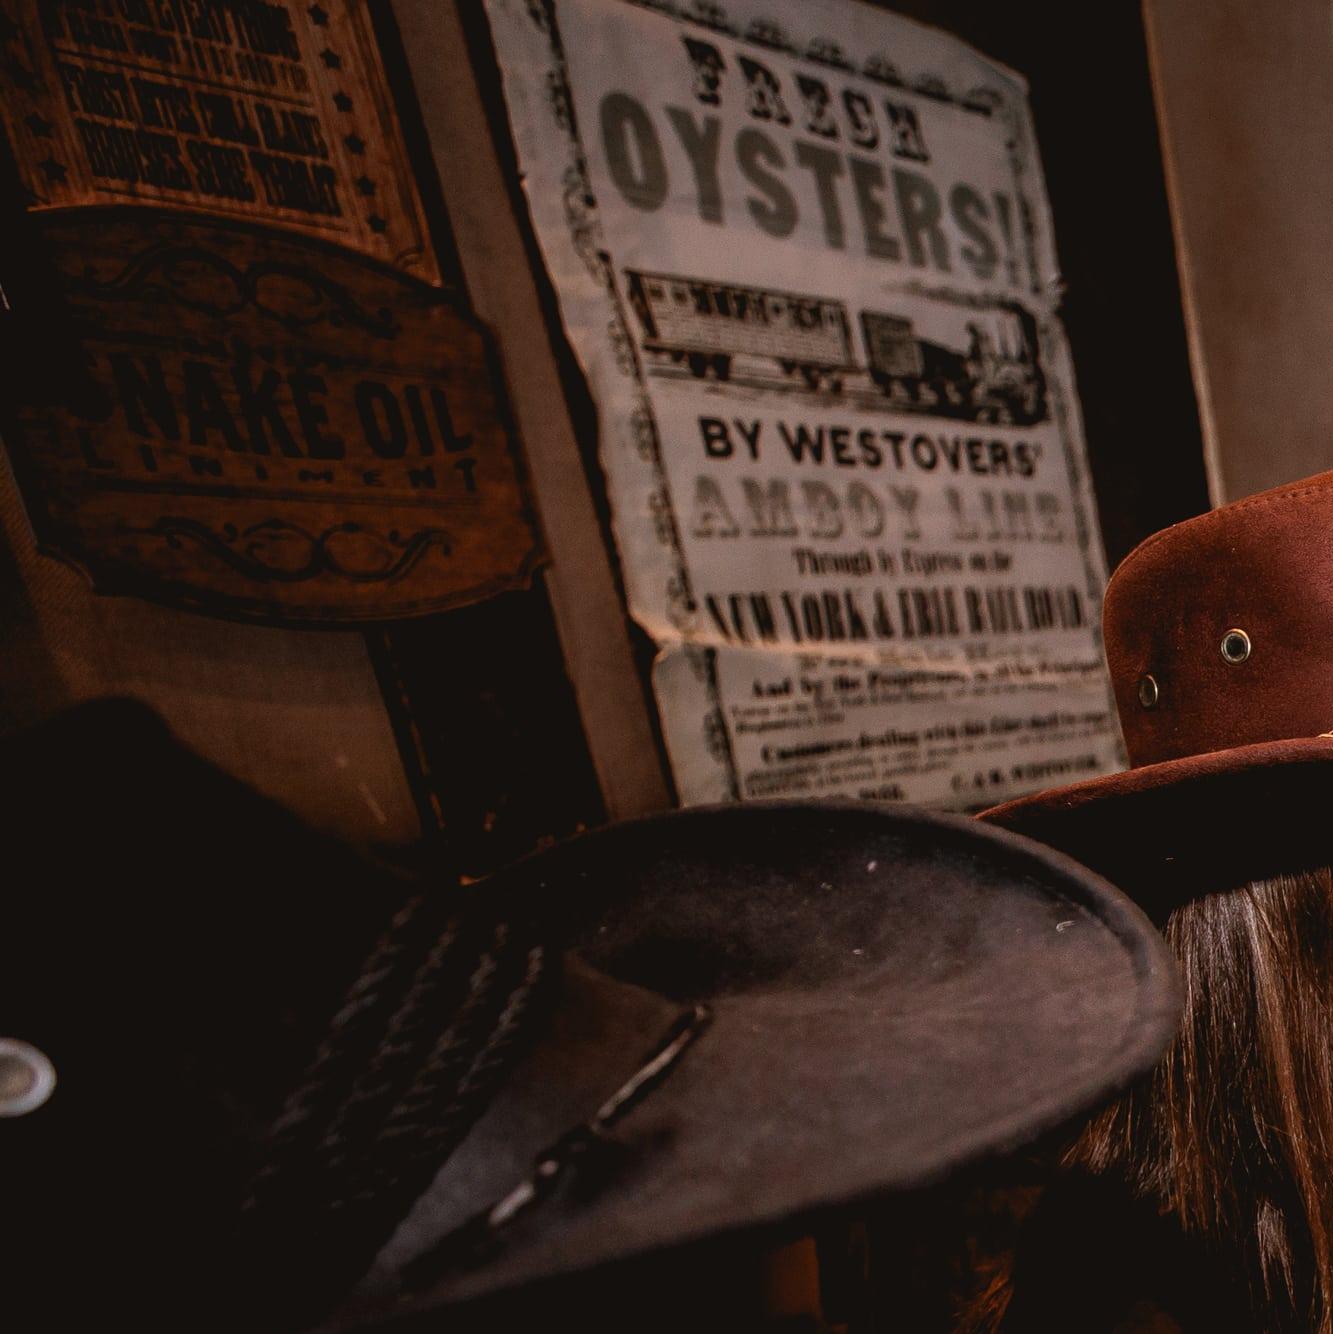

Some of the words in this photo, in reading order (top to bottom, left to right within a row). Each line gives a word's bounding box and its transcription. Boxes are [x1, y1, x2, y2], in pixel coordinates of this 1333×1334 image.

[681, 34, 930, 163] FRESH
[78, 119, 195, 191] BRUISES
[186, 138, 256, 204] SORE
[249, 151, 344, 217] THROAT
[600, 90, 1021, 288] OYSTERS!
[354, 379, 475, 461] OIL
[699, 417, 761, 460] BY
[80, 426, 478, 491] LINIMENT
[692, 476, 921, 540] AMBOY
[944, 486, 1065, 543] LINE
[793, 547, 872, 577] Through
[706, 588, 779, 648] NEW
[780, 588, 867, 643] YORK
[872, 588, 894, 640] &
[899, 584, 961, 638] ERIE
